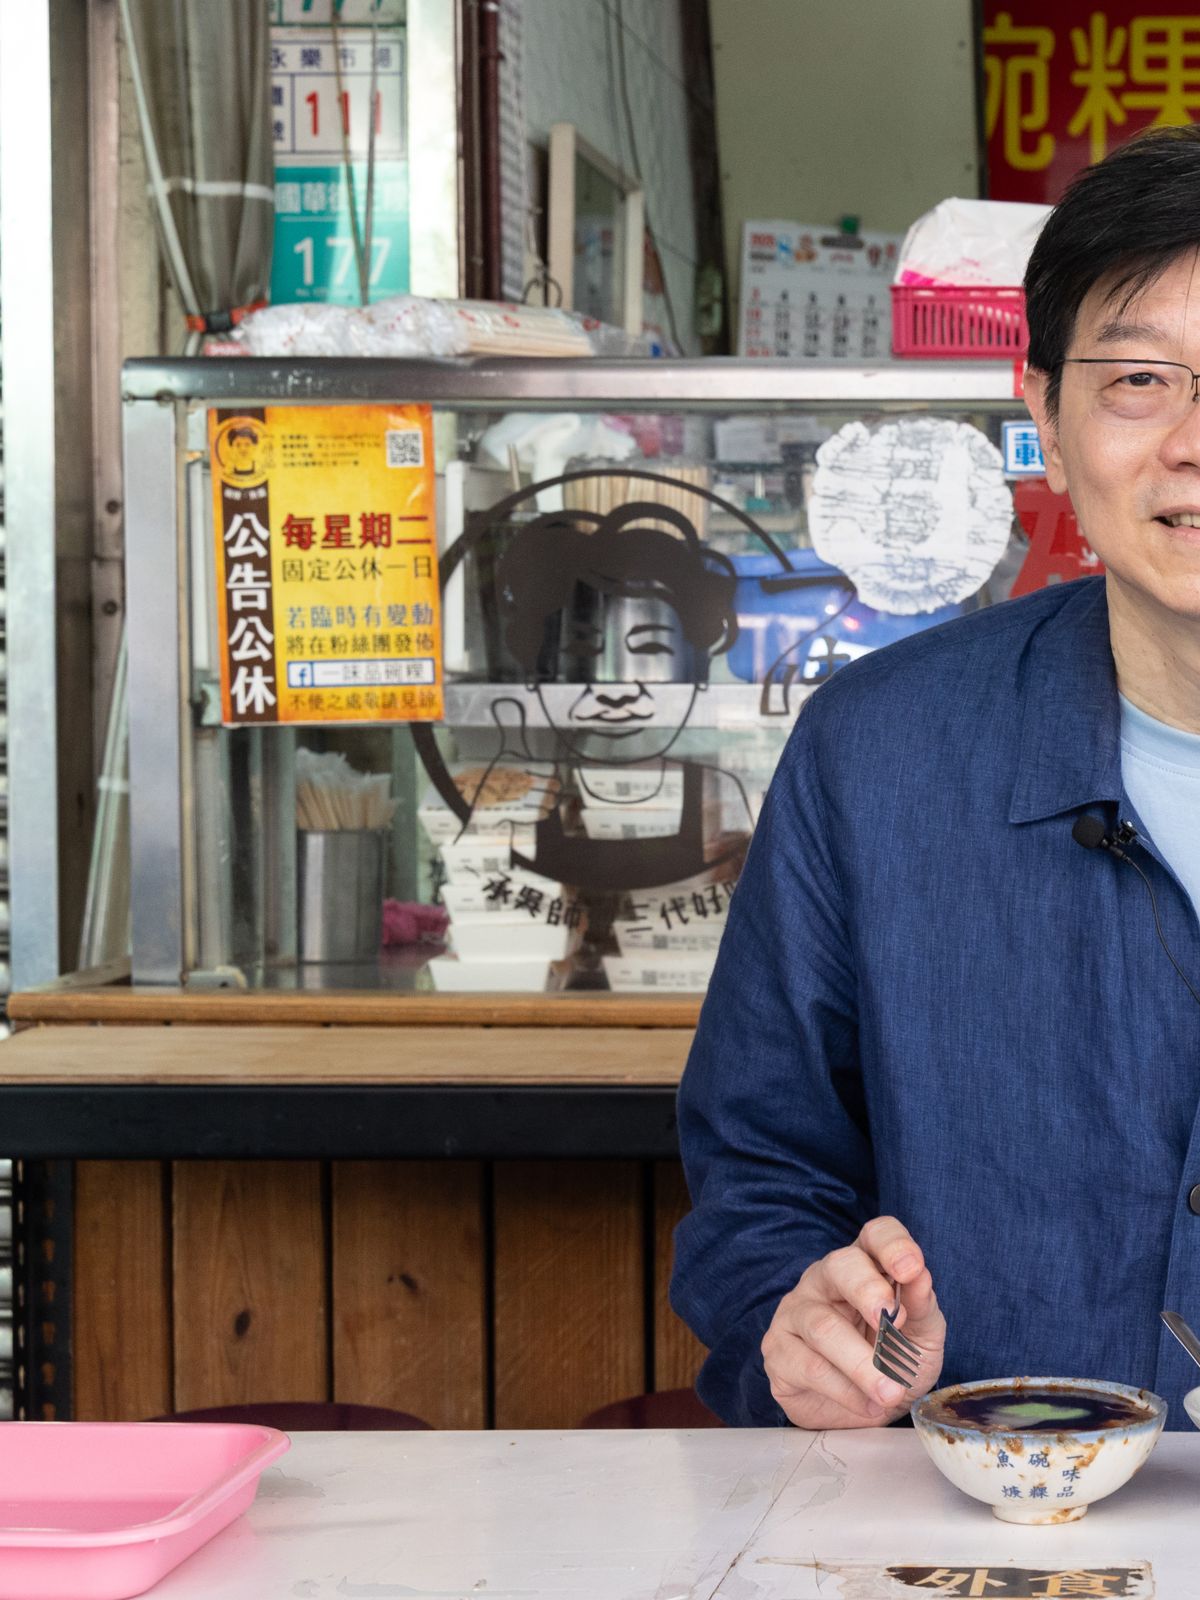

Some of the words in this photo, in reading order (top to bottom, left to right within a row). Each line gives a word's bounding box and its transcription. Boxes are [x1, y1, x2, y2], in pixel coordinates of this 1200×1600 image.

[293, 236, 392, 286] 177
[281, 511, 432, 551] 每星期二
[281, 555, 433, 583] 固定公休一日
[224, 512, 277, 715] 公告公休
[914, 1568, 1121, 1599] 外食
